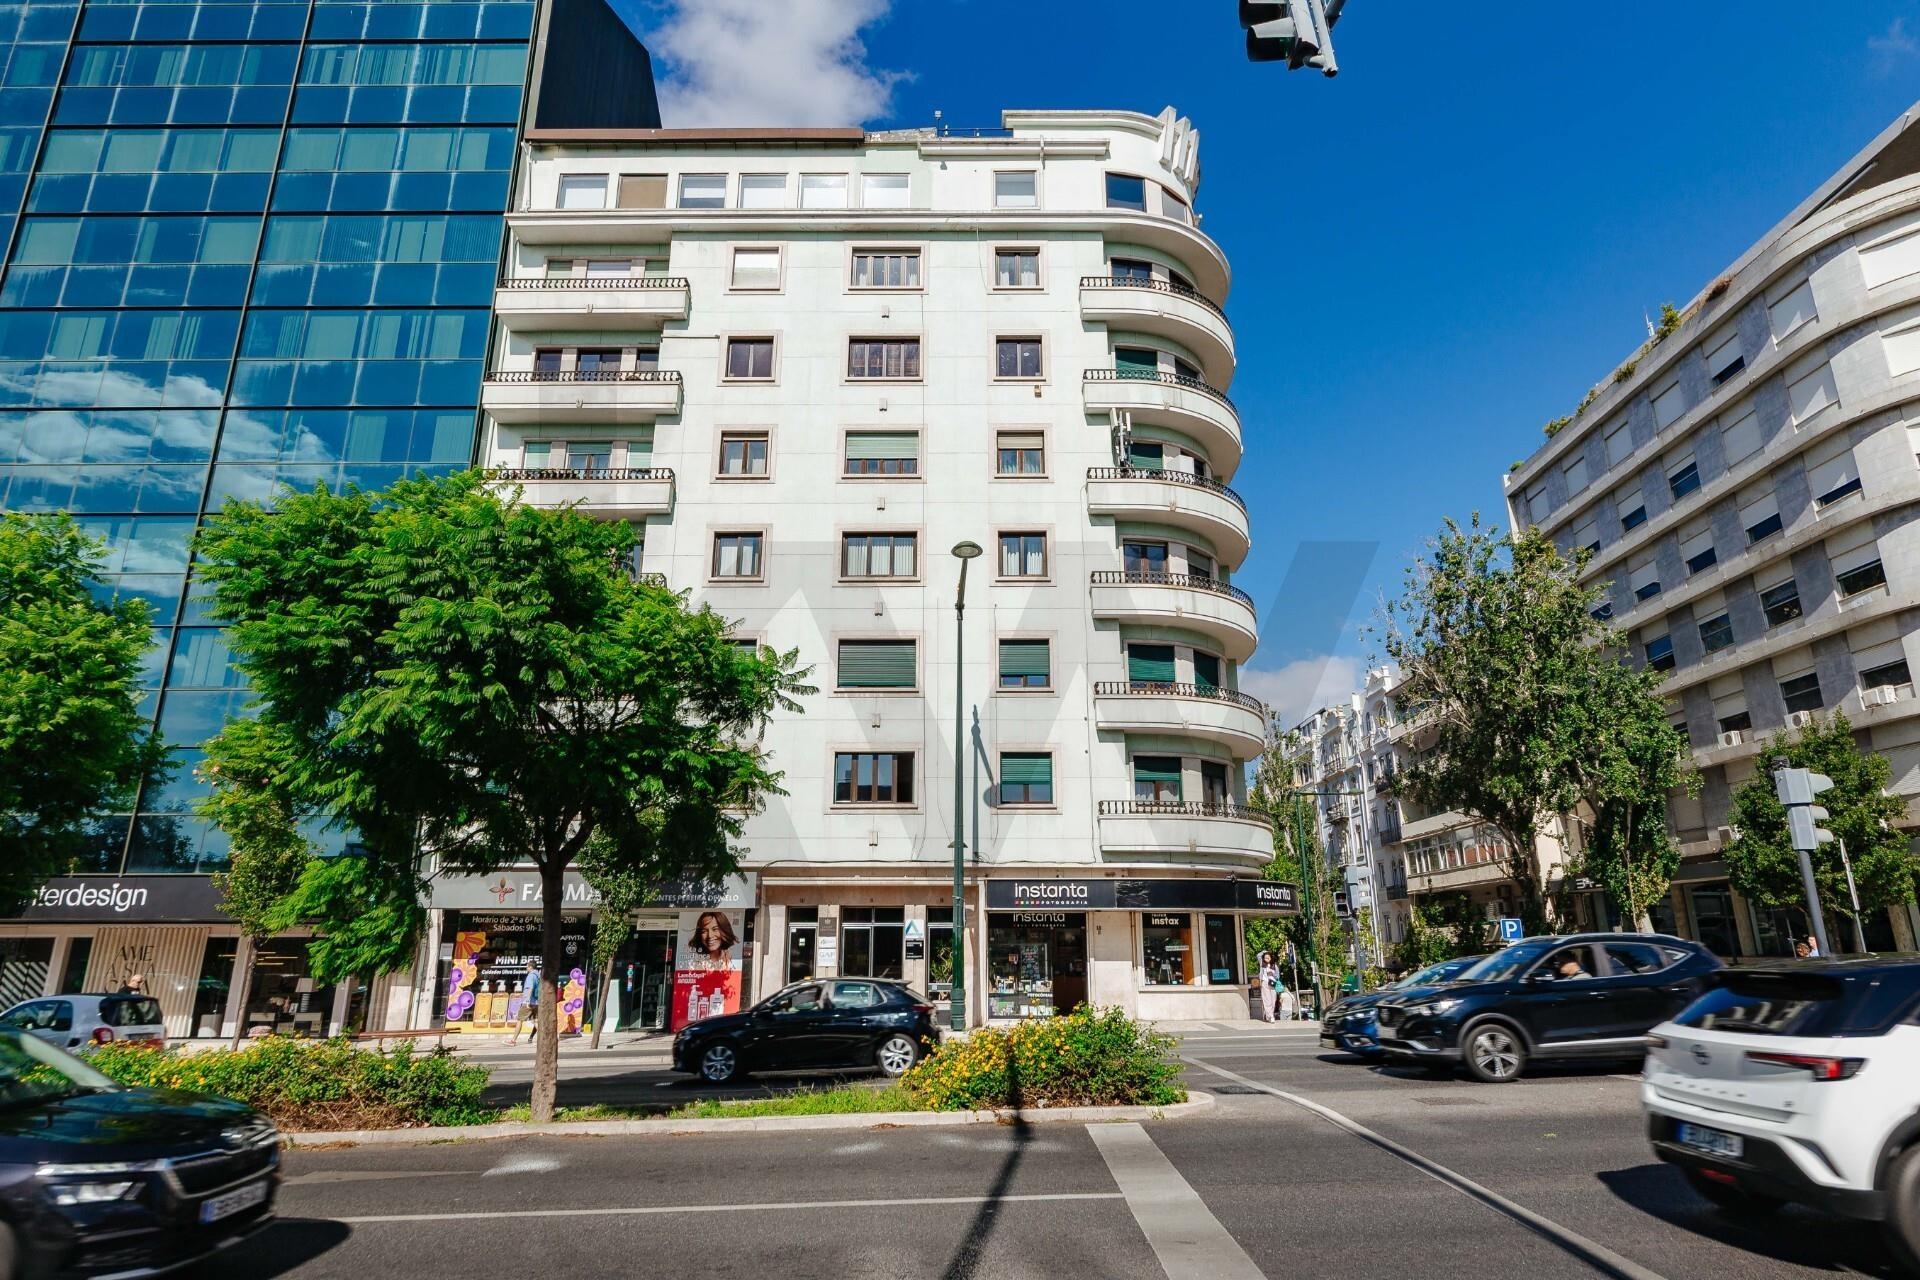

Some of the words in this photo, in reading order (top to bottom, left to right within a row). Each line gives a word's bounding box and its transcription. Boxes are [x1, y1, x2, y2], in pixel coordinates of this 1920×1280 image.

[1014, 882, 1088, 898] instanta
[1256, 884, 1291, 901] instanta
[472, 915, 500, 923] Horário
[500, 915, 509, 923] de
[1151, 917, 1180, 926] instax
[493, 924, 525, 932] Sábados:
[1505, 920, 1518, 938] P
[115, 945, 155, 961] AME
[495, 955, 519, 965] MINI
